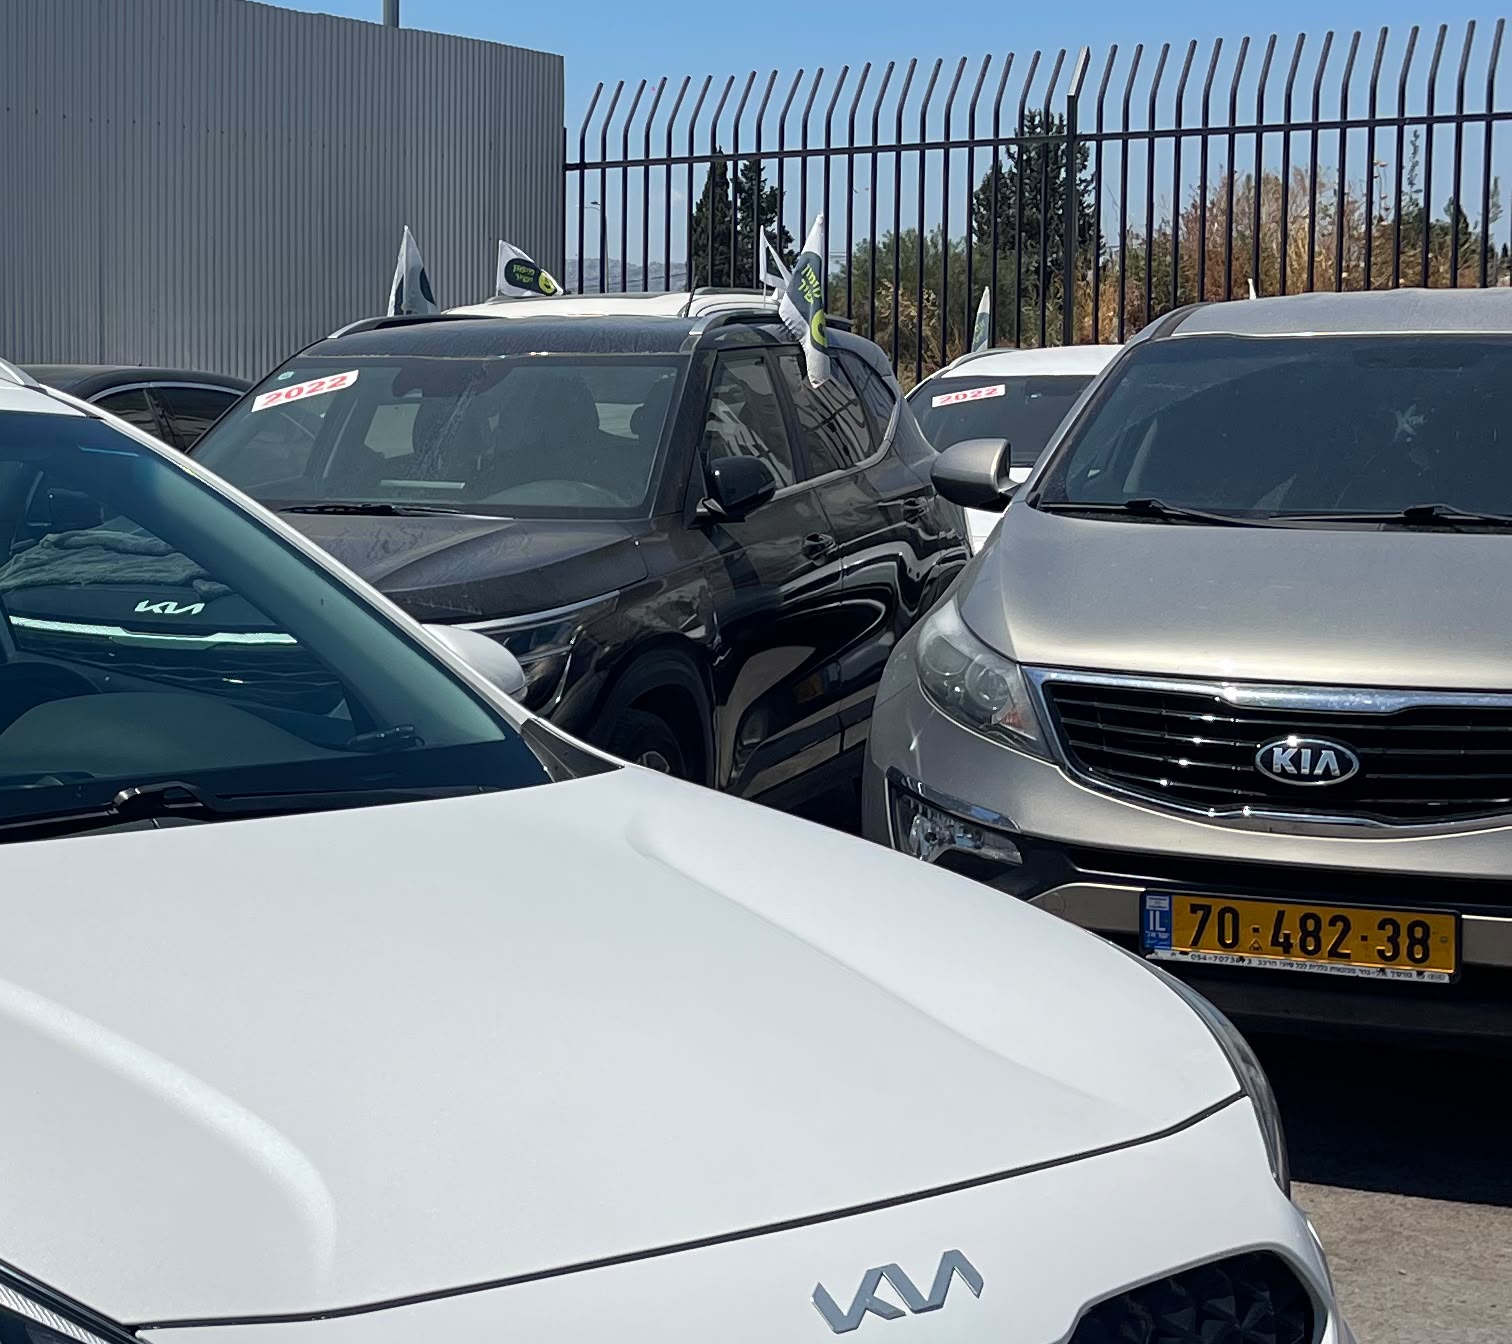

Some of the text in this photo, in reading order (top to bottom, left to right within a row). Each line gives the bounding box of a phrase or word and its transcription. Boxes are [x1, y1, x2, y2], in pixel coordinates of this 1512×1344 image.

[263, 375, 348, 408] 2022
[939, 388, 998, 404] 2022
[1272, 747, 1340, 776] KIA
[1149, 910, 1166, 931] IL
